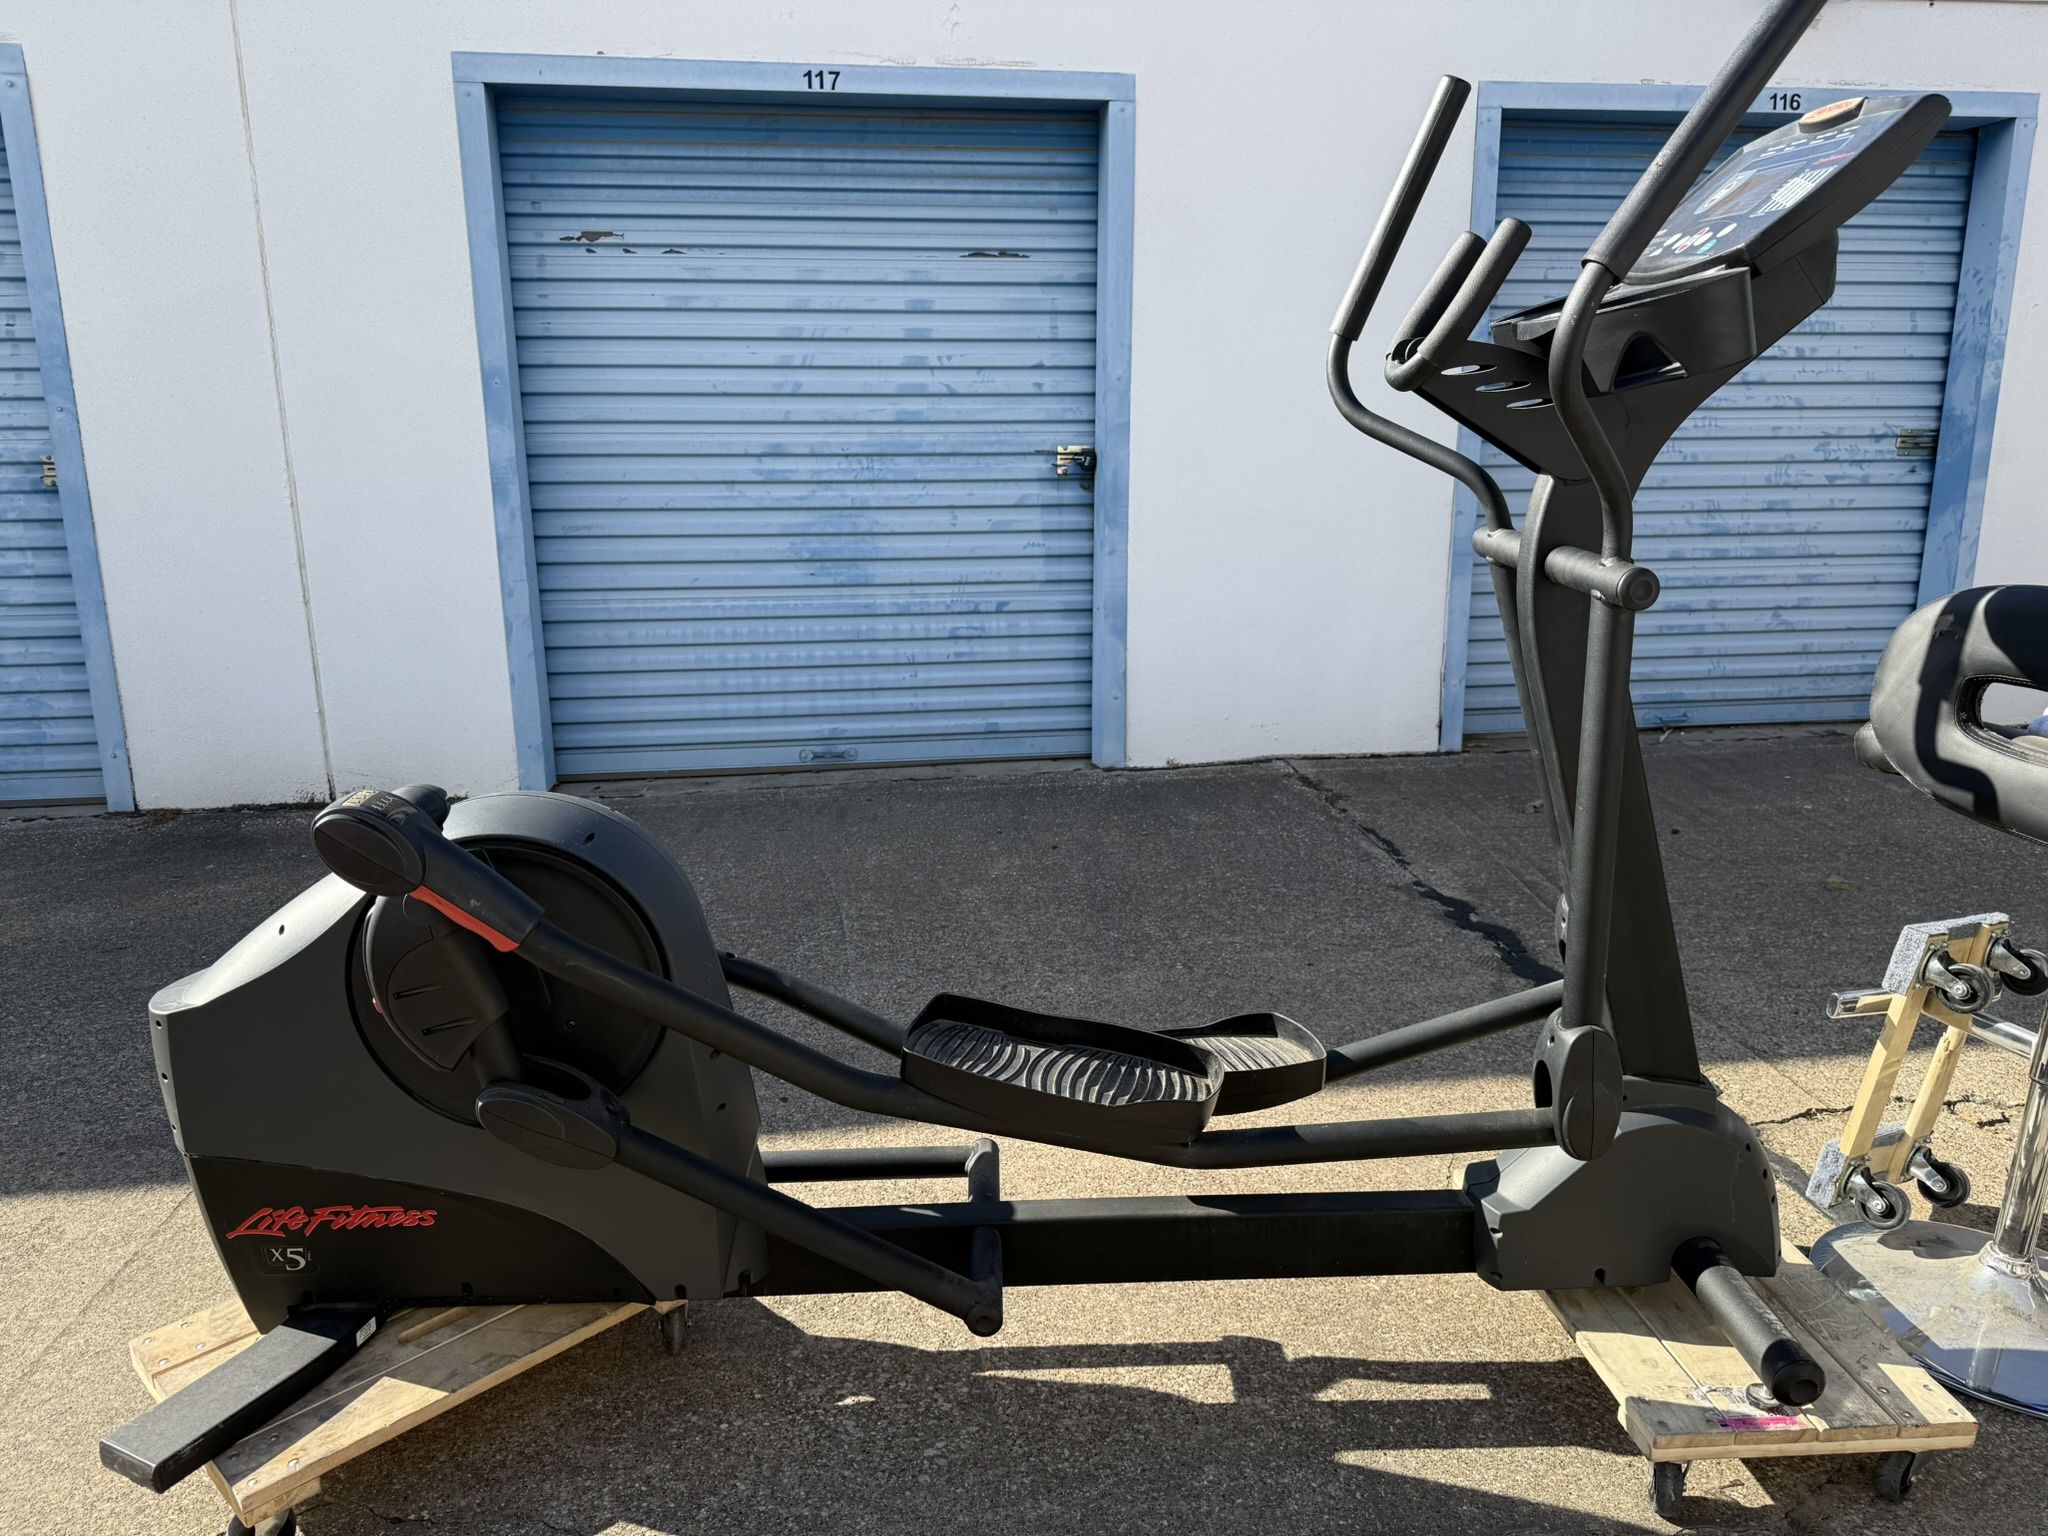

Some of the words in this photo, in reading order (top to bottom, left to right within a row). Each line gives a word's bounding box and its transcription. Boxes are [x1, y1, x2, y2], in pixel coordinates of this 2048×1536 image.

[803, 70, 840, 90] 117
[1770, 93, 1801, 111] 116
[225, 1206, 308, 1239] Life
[304, 1205, 438, 1237] Fitness
